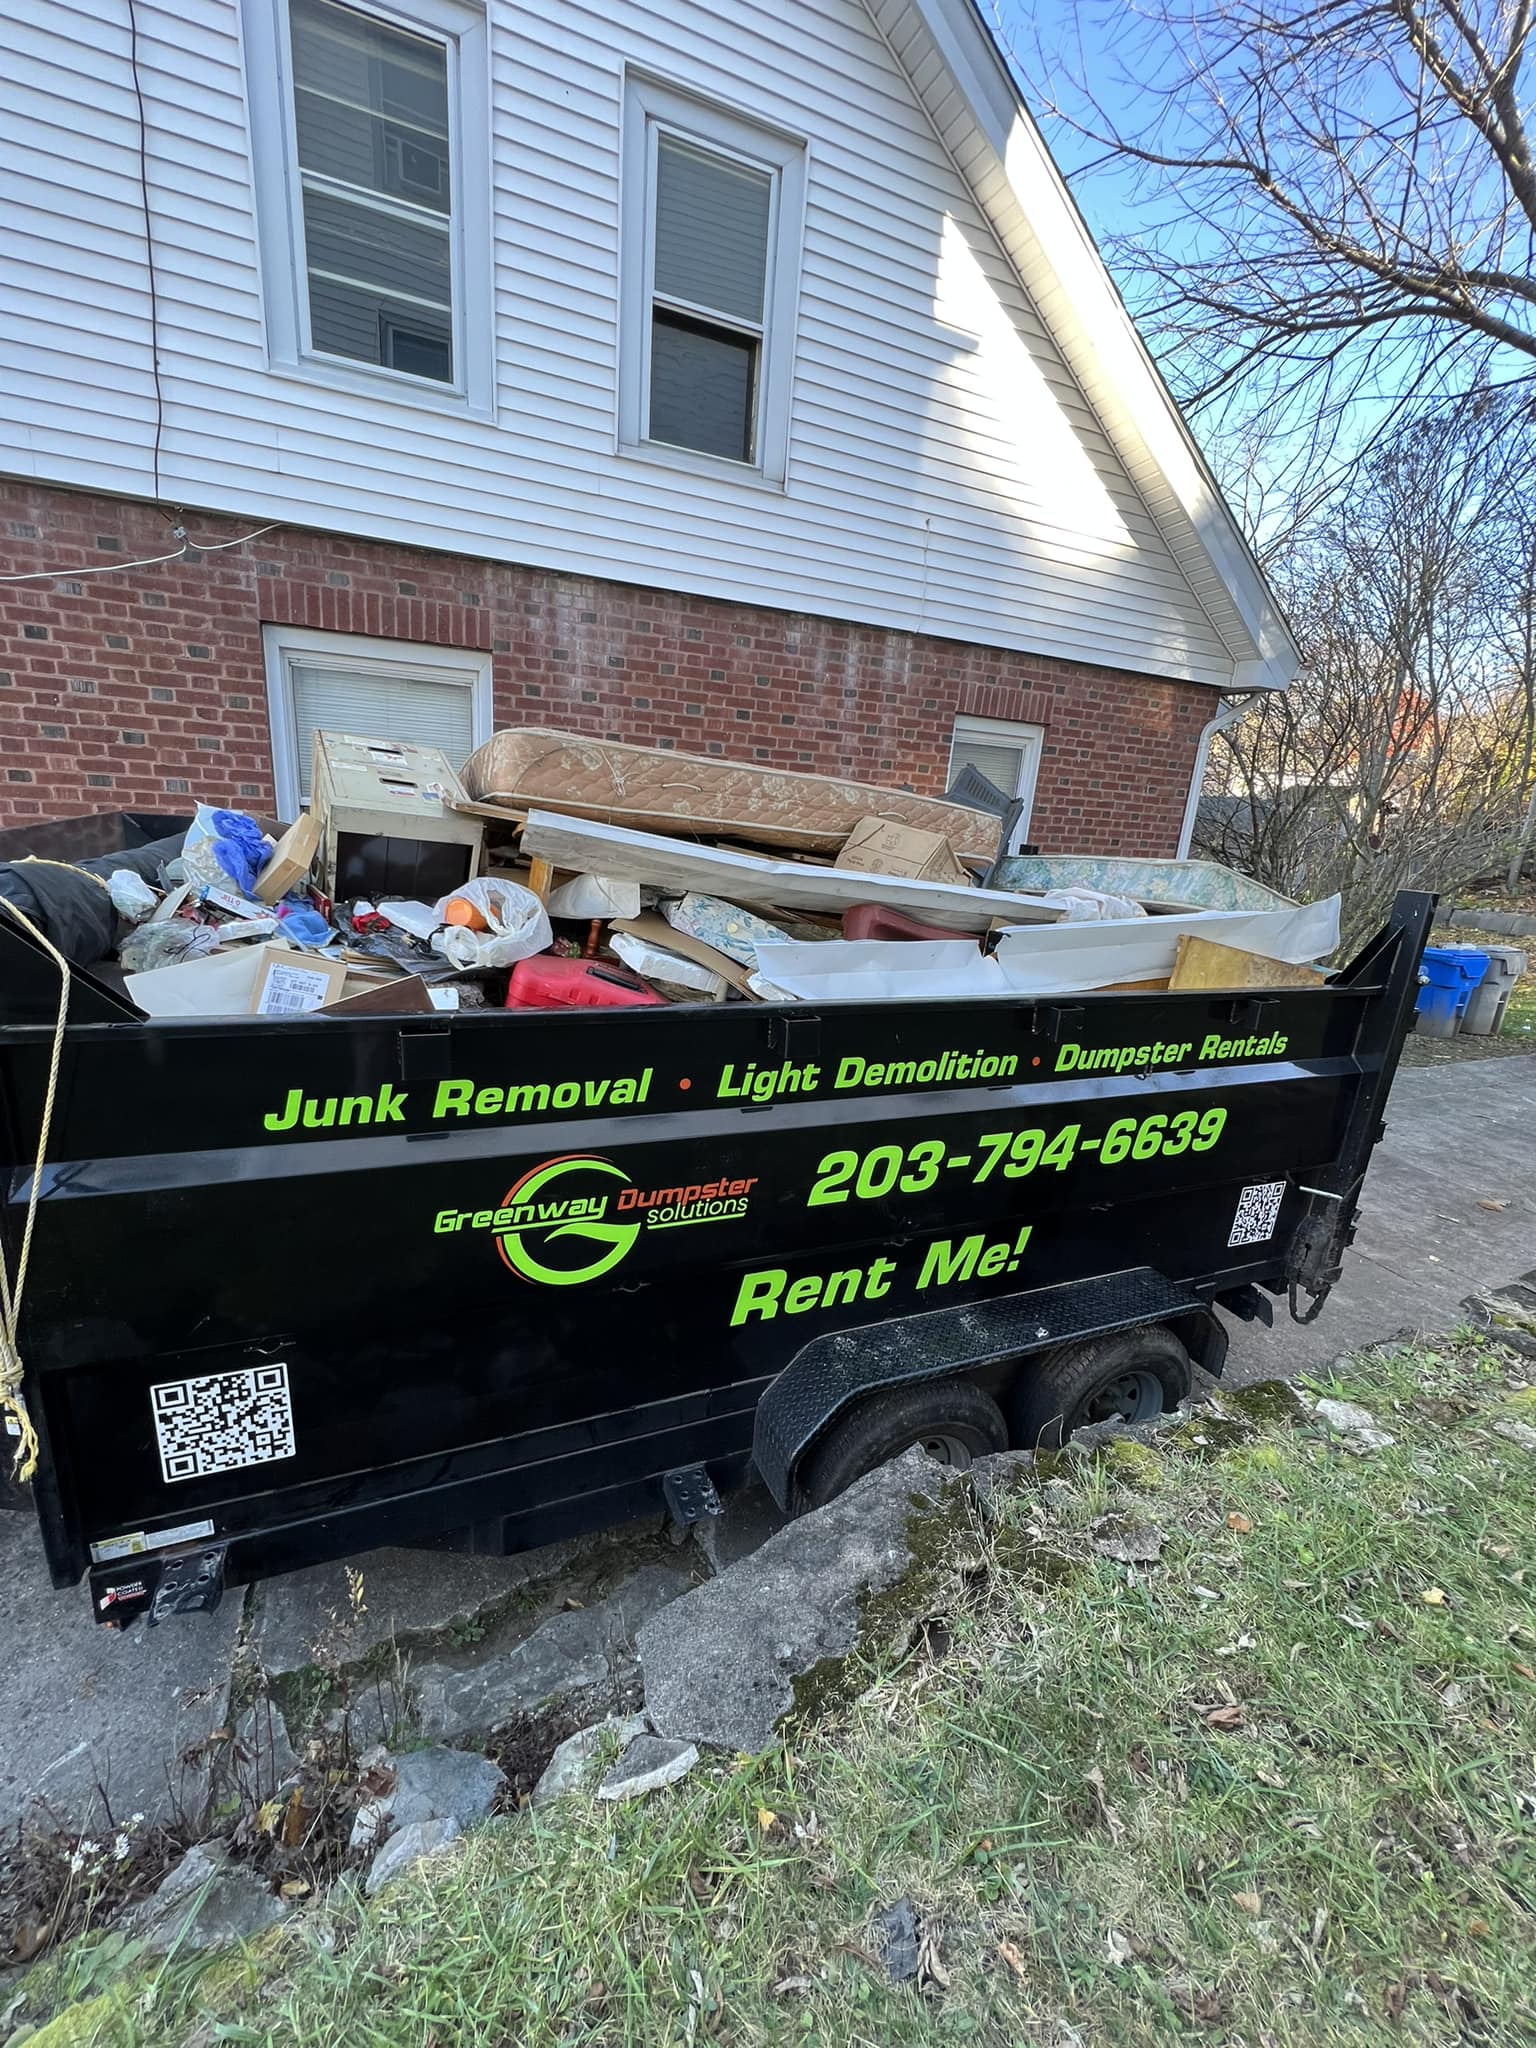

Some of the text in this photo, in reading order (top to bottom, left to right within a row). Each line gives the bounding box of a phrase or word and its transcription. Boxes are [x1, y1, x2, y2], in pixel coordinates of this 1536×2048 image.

[717, 1053, 1019, 1102] Light Demolition
[1055, 1031, 1289, 1073] Dumpster Rentals
[263, 1068, 653, 1131] Junk Removal
[807, 1108, 1228, 1207] 203-794-6639
[434, 1177, 759, 1233] Greenway Dumpster
[646, 1197, 749, 1224] solutions
[730, 1226, 1033, 1327] Rent Me!
